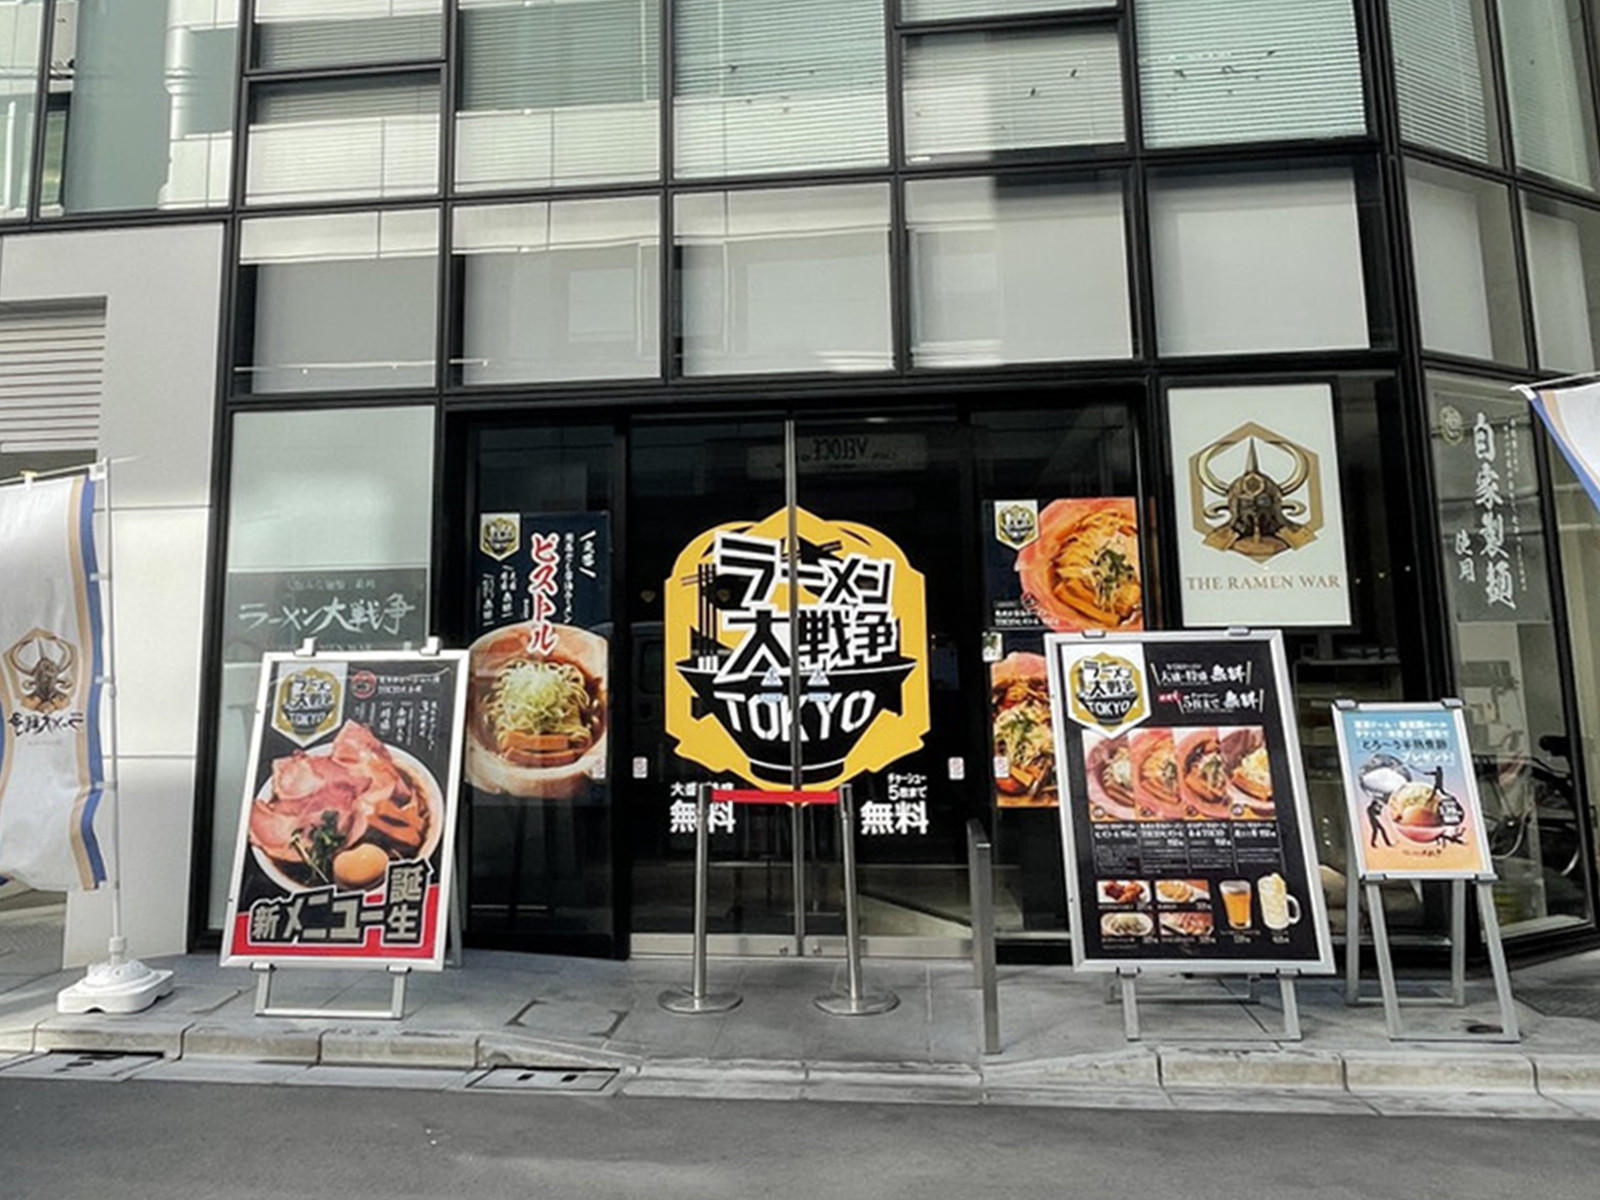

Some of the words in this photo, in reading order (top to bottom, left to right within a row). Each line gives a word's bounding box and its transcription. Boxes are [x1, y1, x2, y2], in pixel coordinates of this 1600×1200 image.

[1473, 412, 1516, 609] 自家製麺
[714, 530, 894, 609] ラーメン
[1186, 576, 1223, 591] THE
[1228, 575, 1294, 590] RAMEN
[1300, 574, 1341, 589] WAR
[238, 592, 415, 636] ラーメン大戦争
[712, 603, 900, 685] 大戦争
[713, 690, 876, 742] TOKYO
[1087, 700, 1131, 716] TOKYO
[860, 800, 930, 836] 無料
